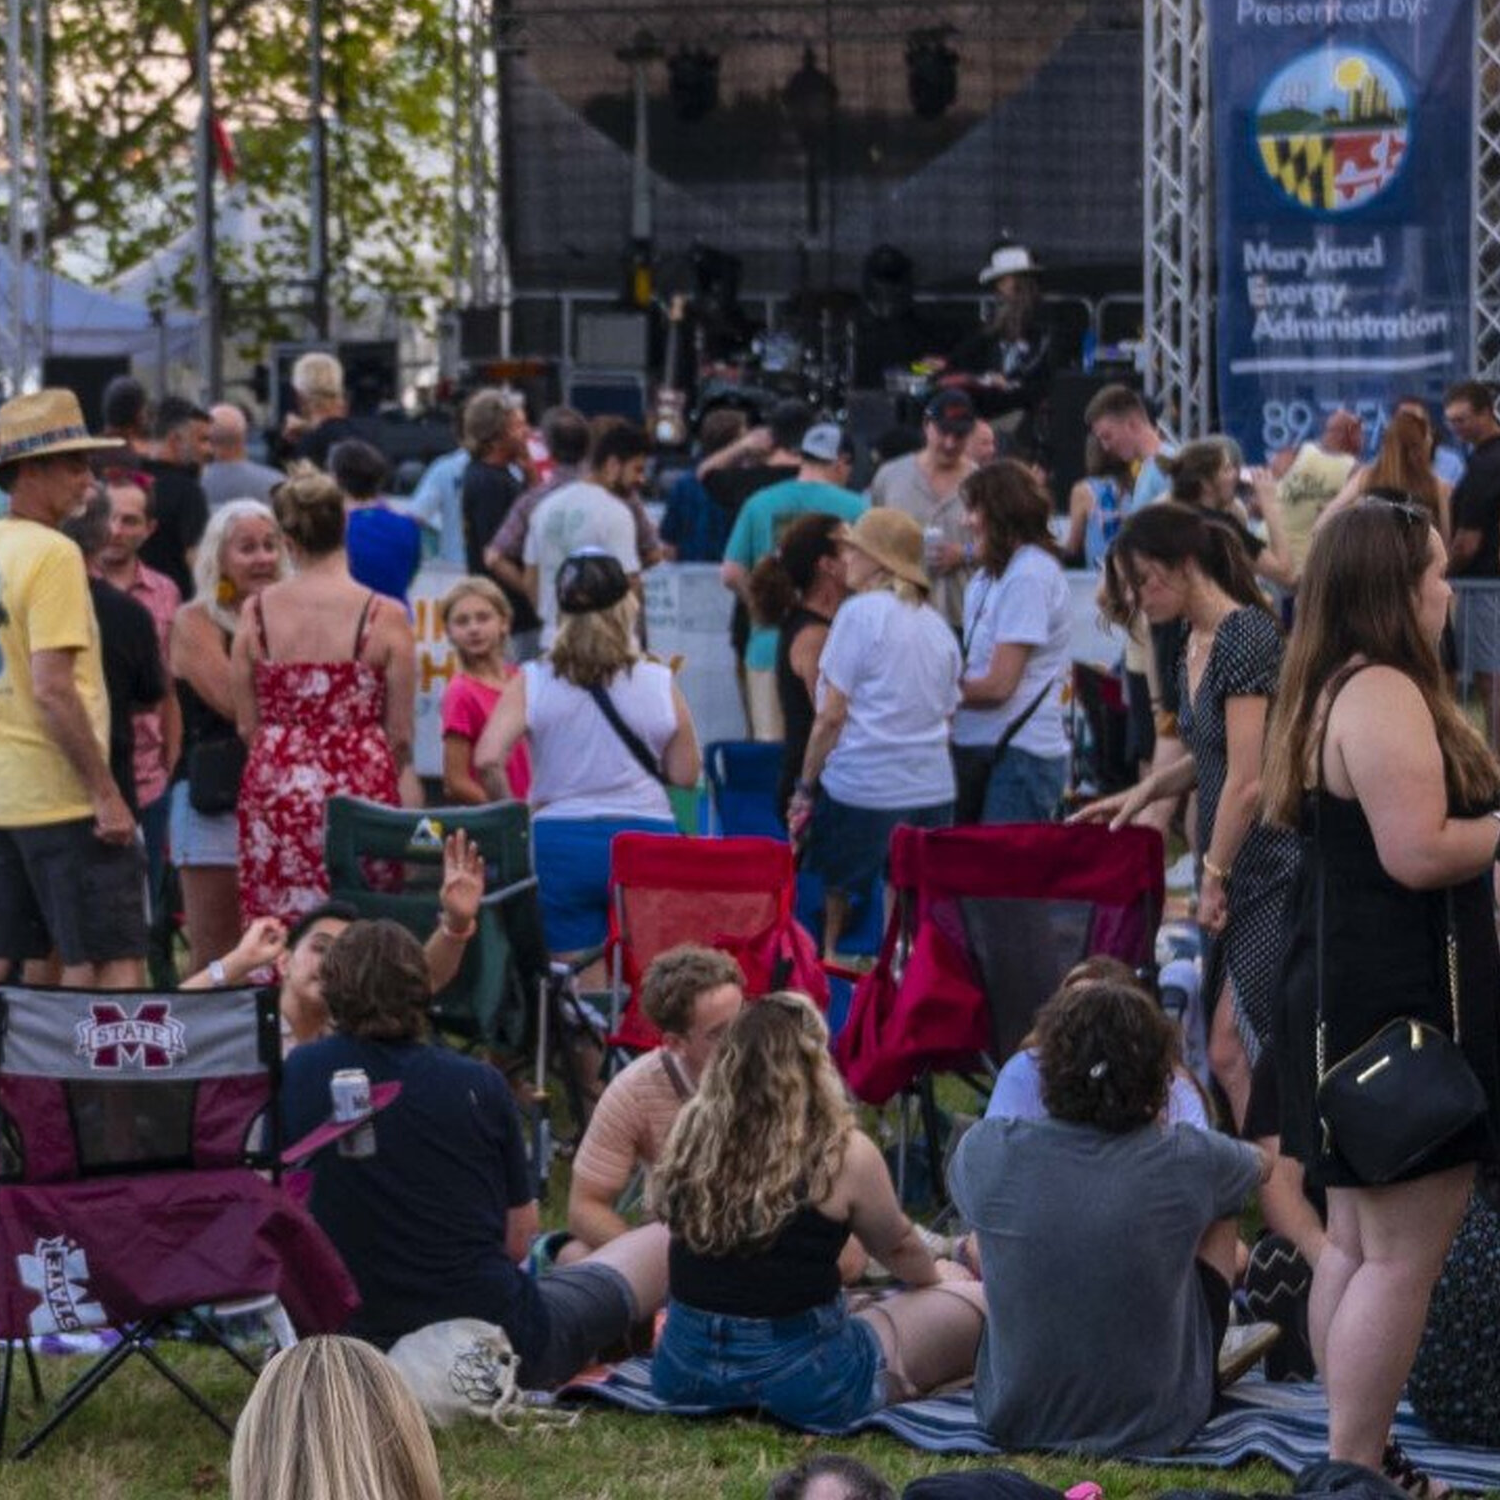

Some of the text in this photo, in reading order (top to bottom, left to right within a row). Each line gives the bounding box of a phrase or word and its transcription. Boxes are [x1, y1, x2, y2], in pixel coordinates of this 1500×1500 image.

[1243, 236, 1384, 277] Maryland
[1248, 274, 1347, 317] Energy
[1252, 308, 1449, 342] Administration
[94, 1021, 170, 1047] STATE
